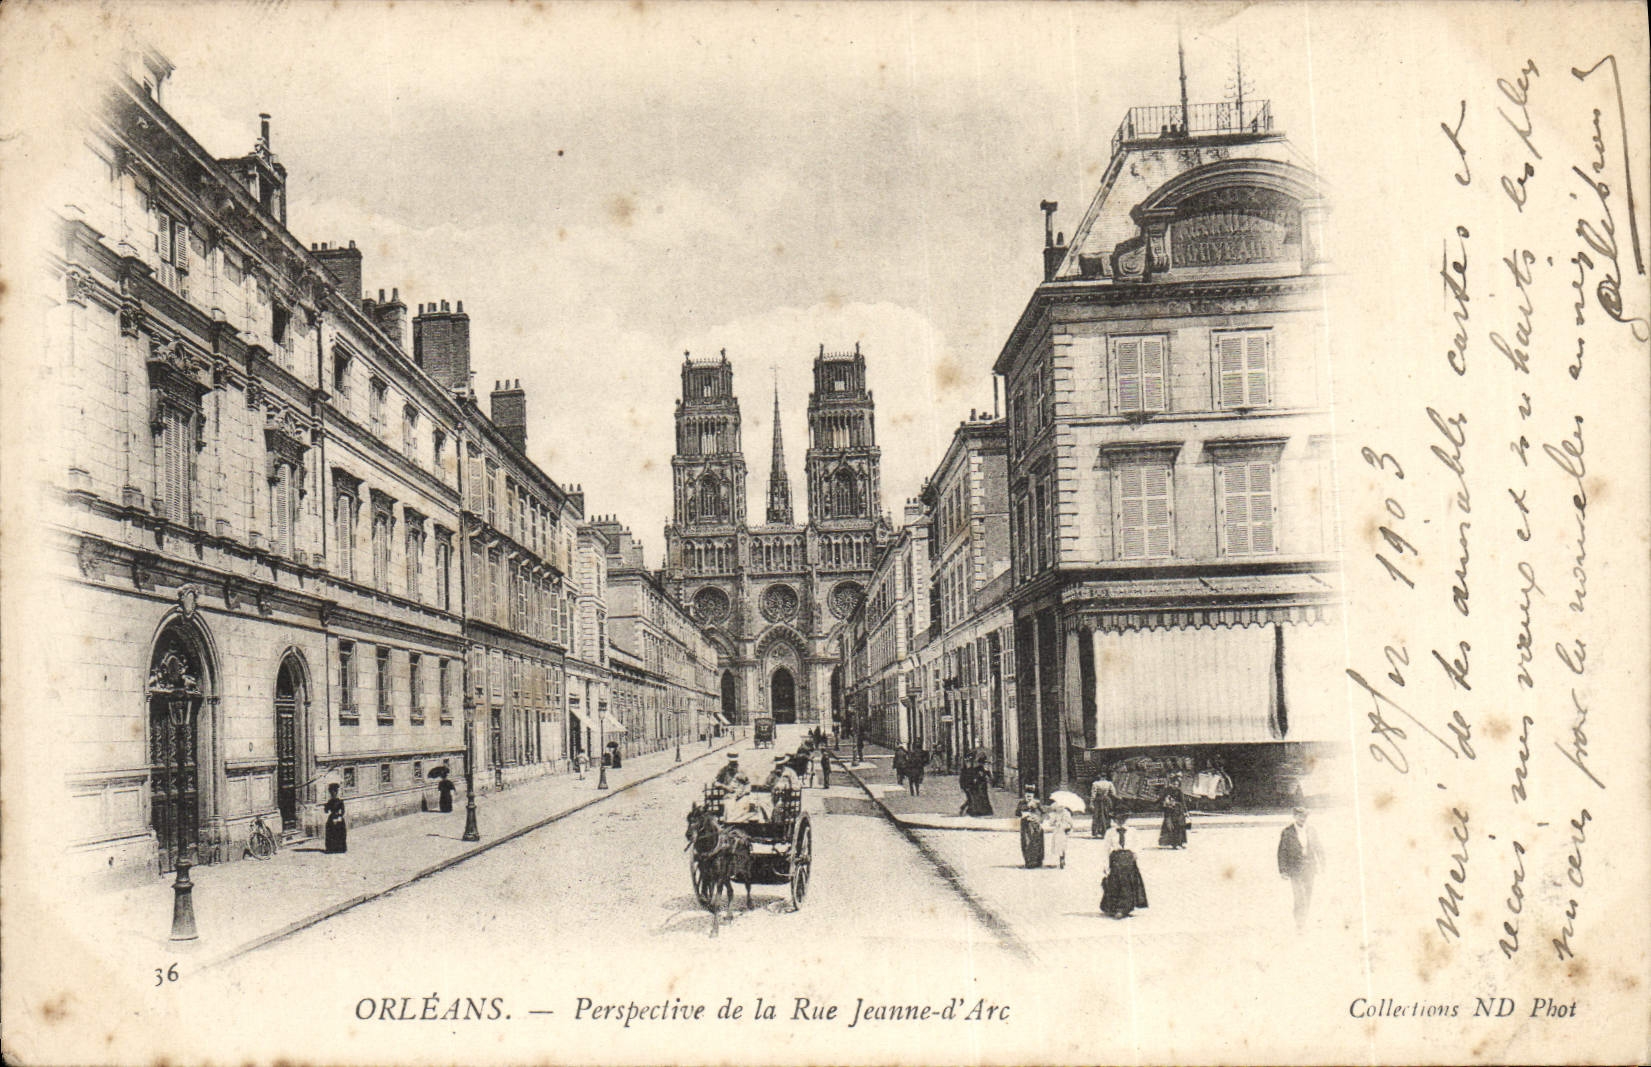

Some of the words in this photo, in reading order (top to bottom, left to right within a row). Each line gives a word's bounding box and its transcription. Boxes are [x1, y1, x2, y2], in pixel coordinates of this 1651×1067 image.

[1440, 99, 1472, 187] et
[1440, 226, 1471, 377] cartes
[1361, 447, 1419, 589] 1903
[1507, 488, 1532, 542] et
[1555, 639, 1587, 675] la
[1446, 711, 1477, 762] de
